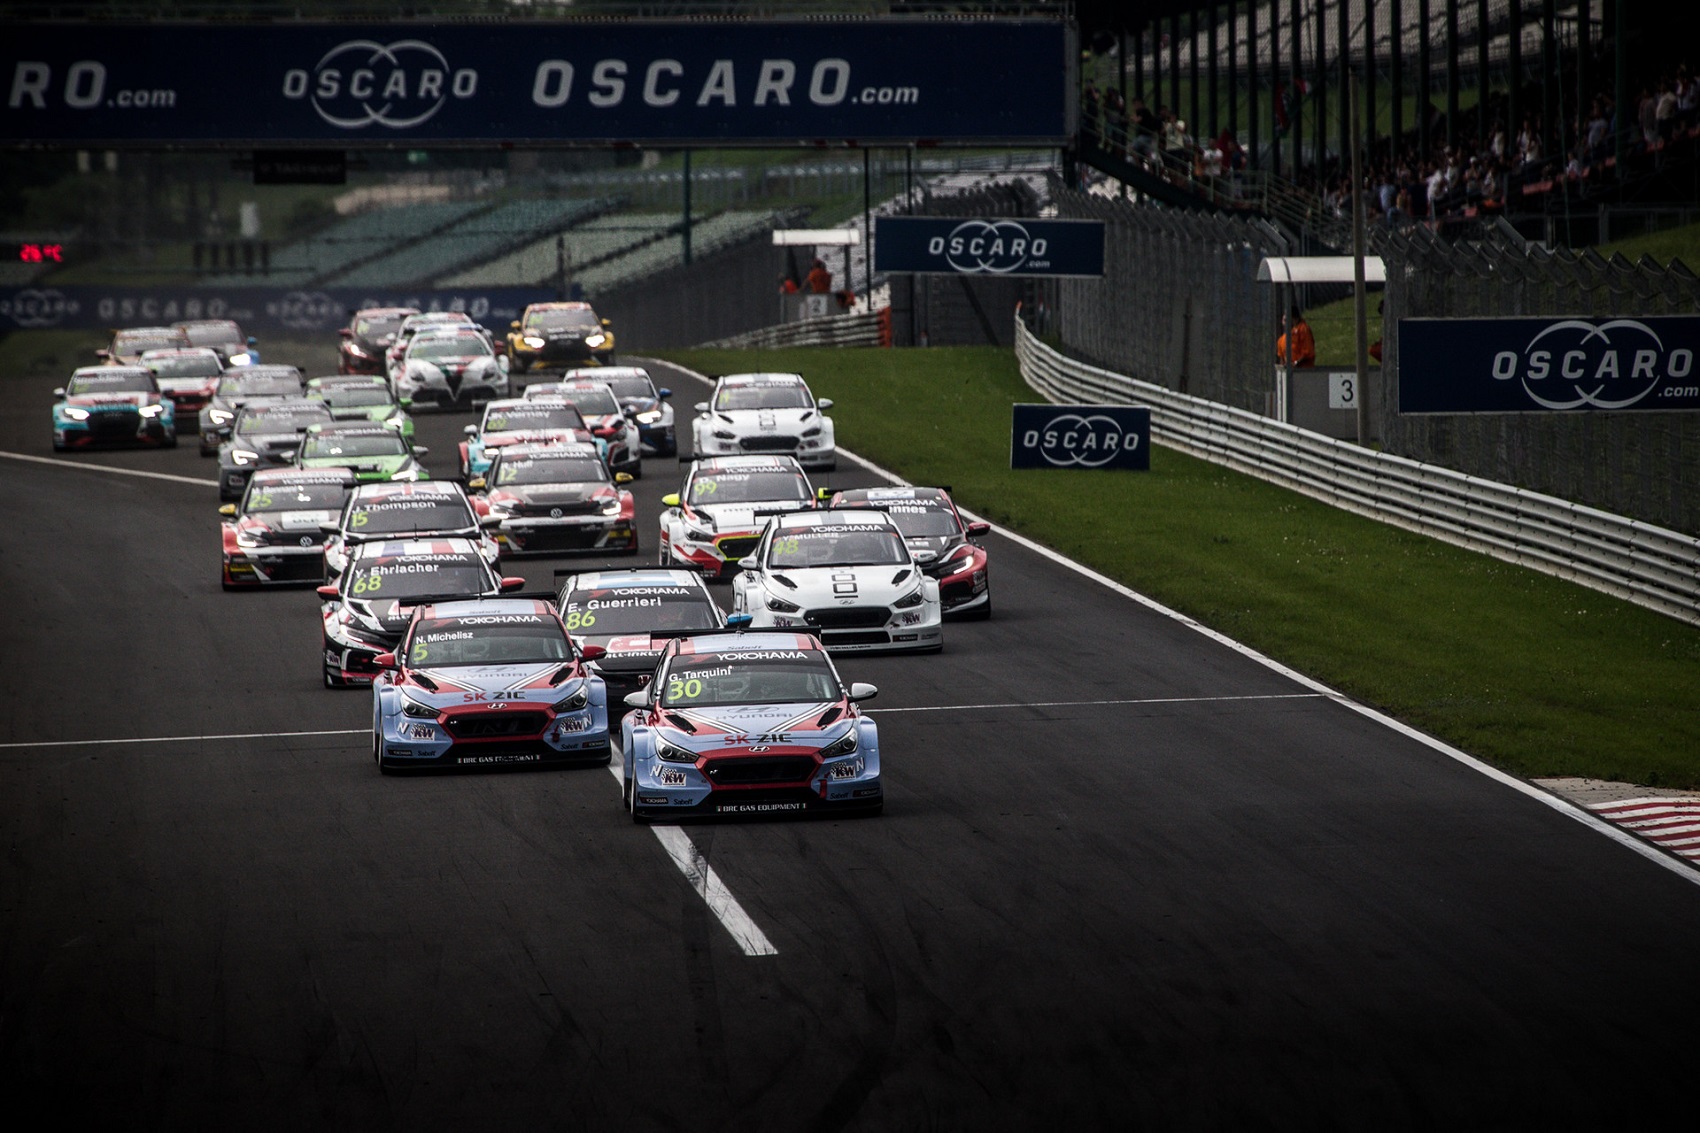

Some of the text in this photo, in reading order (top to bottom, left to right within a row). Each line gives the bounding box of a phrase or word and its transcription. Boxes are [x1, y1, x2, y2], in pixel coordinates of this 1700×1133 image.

[282, 67, 479, 101] OSCARO
[531, 57, 920, 109] OSCARO.com
[928, 235, 1048, 257] OSCARO
[1491, 348, 1694, 381] OSCARO
[1341, 379, 1355, 402] 3
[1022, 429, 1140, 451] OSCARO
[694, 482, 717, 496] 99
[249, 494, 273, 508] 25
[388, 493, 451, 502] YOKOHAMA
[870, 499, 937, 507] YOKOHAMA
[363, 500, 436, 511] Thompson
[351, 511, 368, 528] 15
[810, 524, 883, 533] YOKOHAMA
[772, 539, 800, 556] 48
[395, 554, 468, 563] YOKOHAMA
[370, 563, 440, 575] Ehrlacher
[353, 575, 383, 594] 68
[610, 587, 691, 596] YOKOHAMA
[567, 596, 662, 613] E. Guerrieri
[457, 615, 542, 625] YOKOHAMA
[566, 610, 596, 631] 86
[416, 631, 474, 644] N. Michelisz
[413, 643, 428, 662] 5
[716, 651, 808, 661] YOKOHAMA
[669, 666, 732, 683] G. Tarquini
[463, 690, 526, 703] SK ZIC
[667, 679, 702, 701] 30
[583, 713, 593, 728] N
[716, 713, 793, 721] HYUNDAI
[396, 721, 410, 735] N
[565, 720, 583, 732] KW
[414, 728, 434, 739] KW
[724, 733, 793, 746] SK ZIC
[650, 764, 664, 778] N
[835, 765, 855, 777] KW
[856, 756, 865, 773] N
[664, 773, 686, 784] KW
[723, 802, 801, 813] BRC GAS EQUIPMENT
